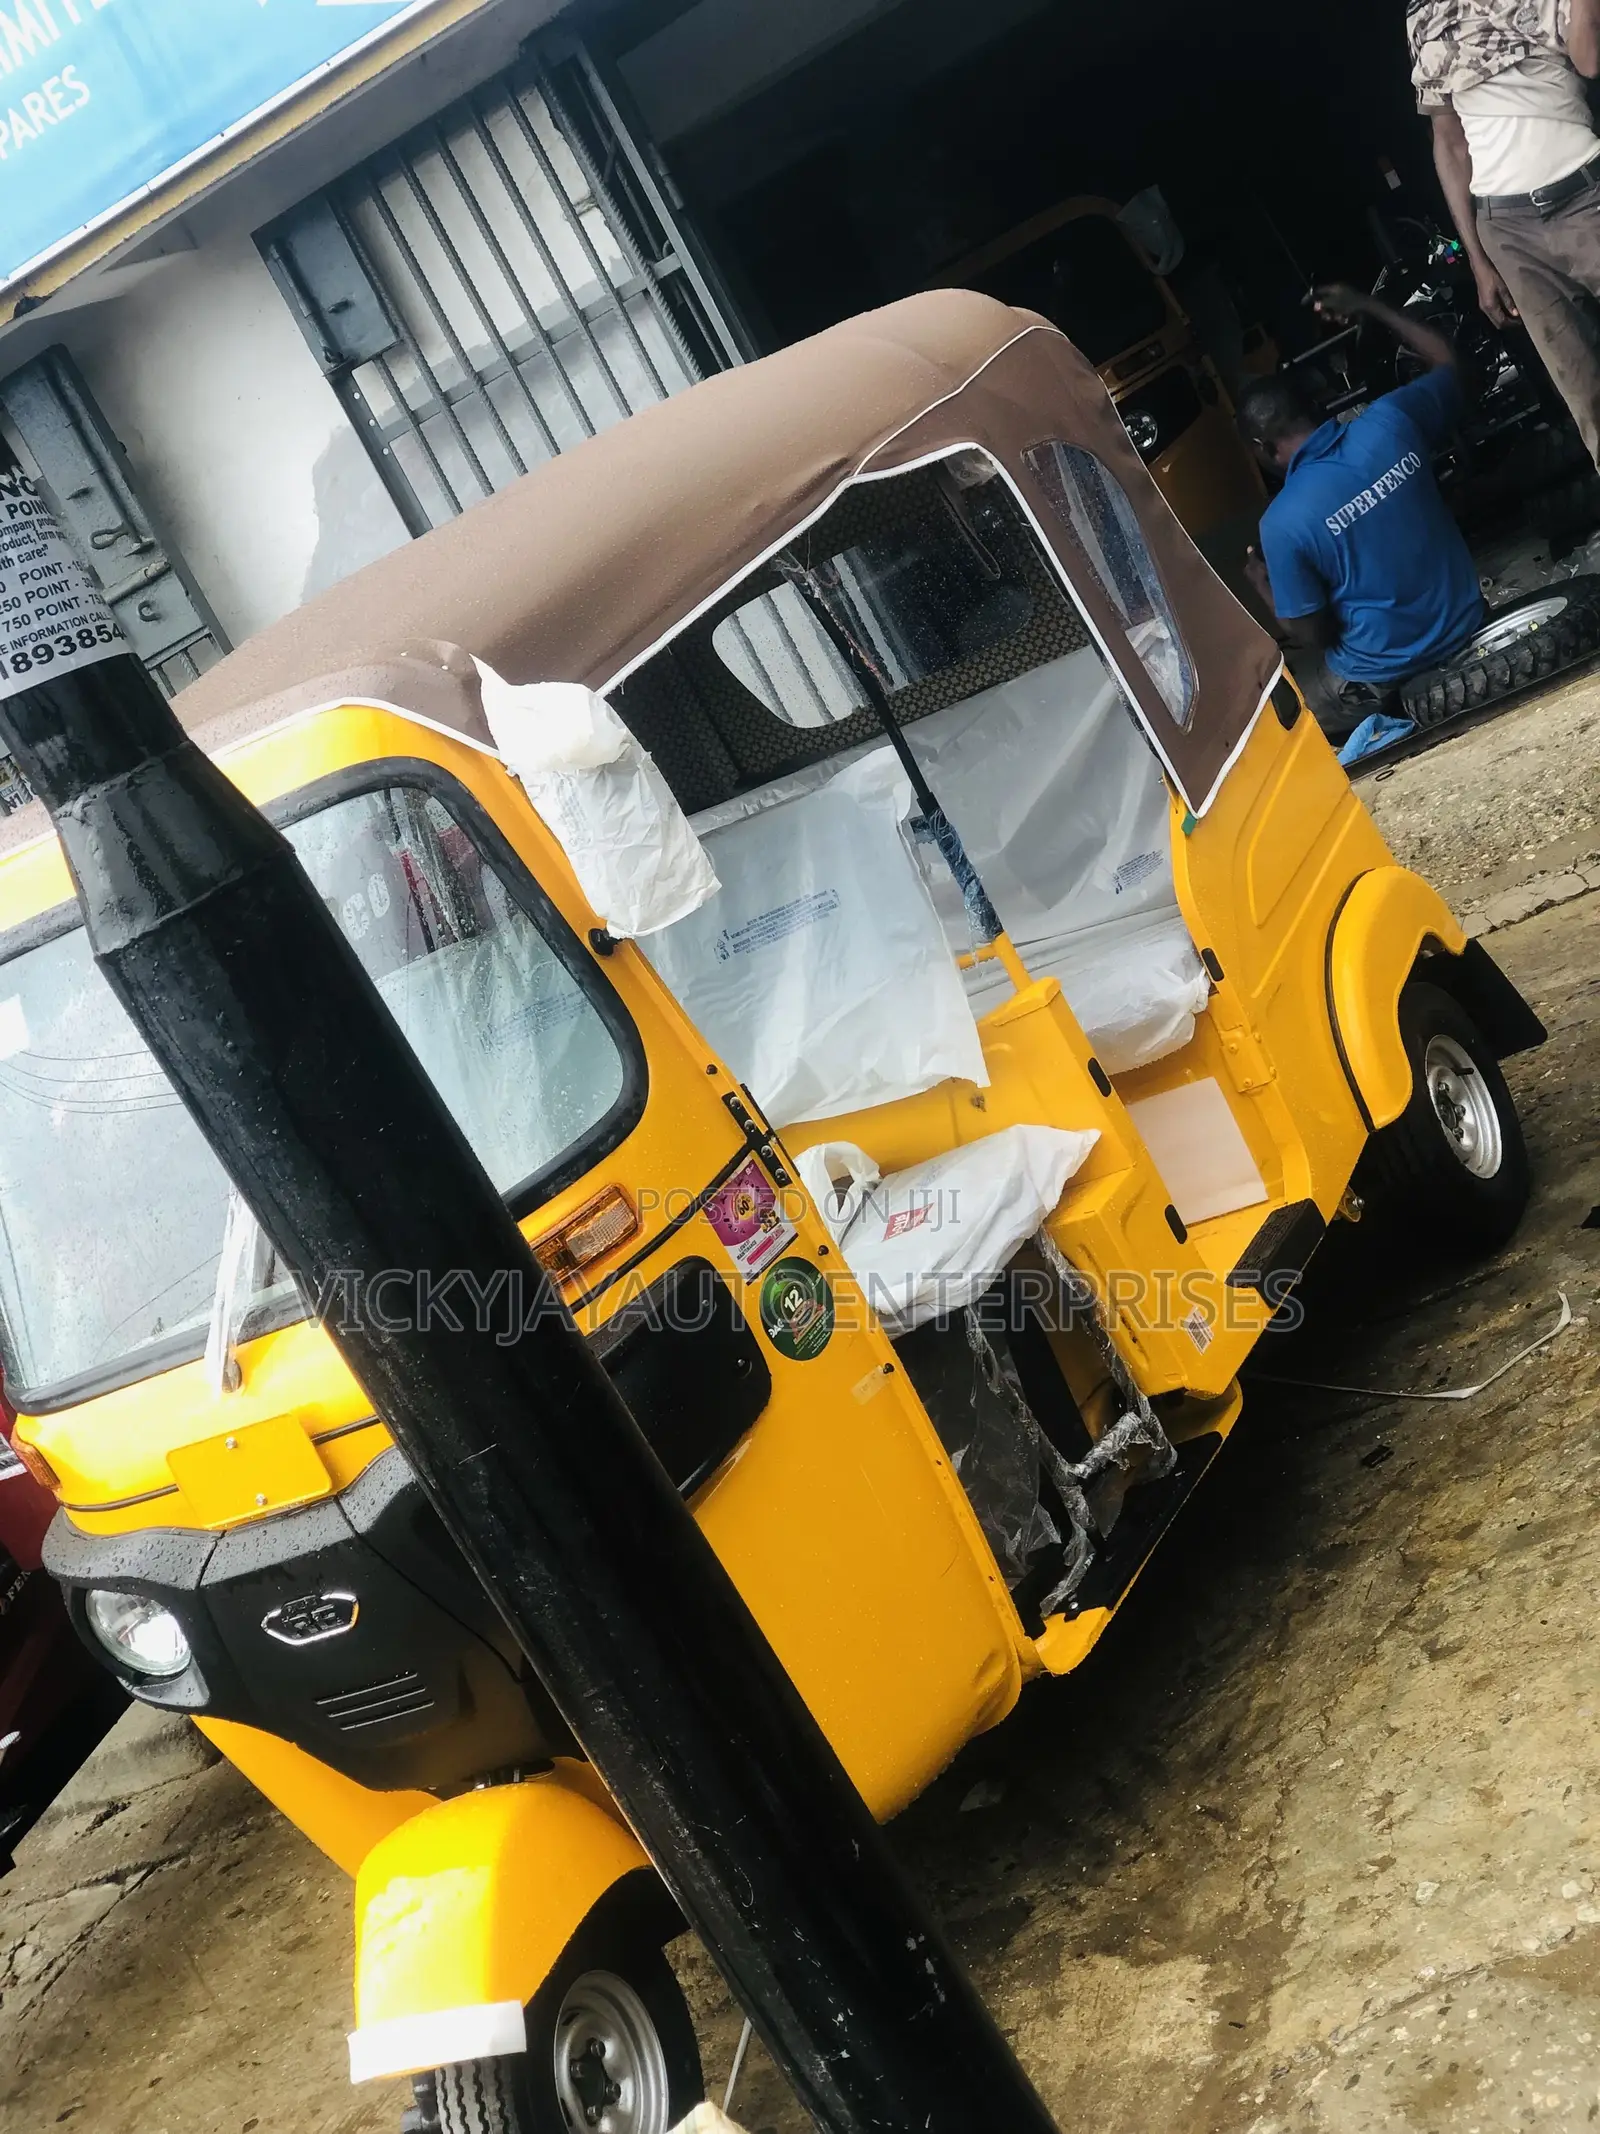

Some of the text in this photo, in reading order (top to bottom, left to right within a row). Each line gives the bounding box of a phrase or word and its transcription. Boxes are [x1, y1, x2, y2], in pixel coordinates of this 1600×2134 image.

[1371, 451, 1422, 500] FENCO
[18, 562, 64, 585] POINT
[24, 579, 71, 604] POINT
[2, 613, 31, 633] 750
[34, 596, 81, 621] POINT
[9, 615, 89, 651] INFORMATION
[784, 1289, 803, 1313] 12
